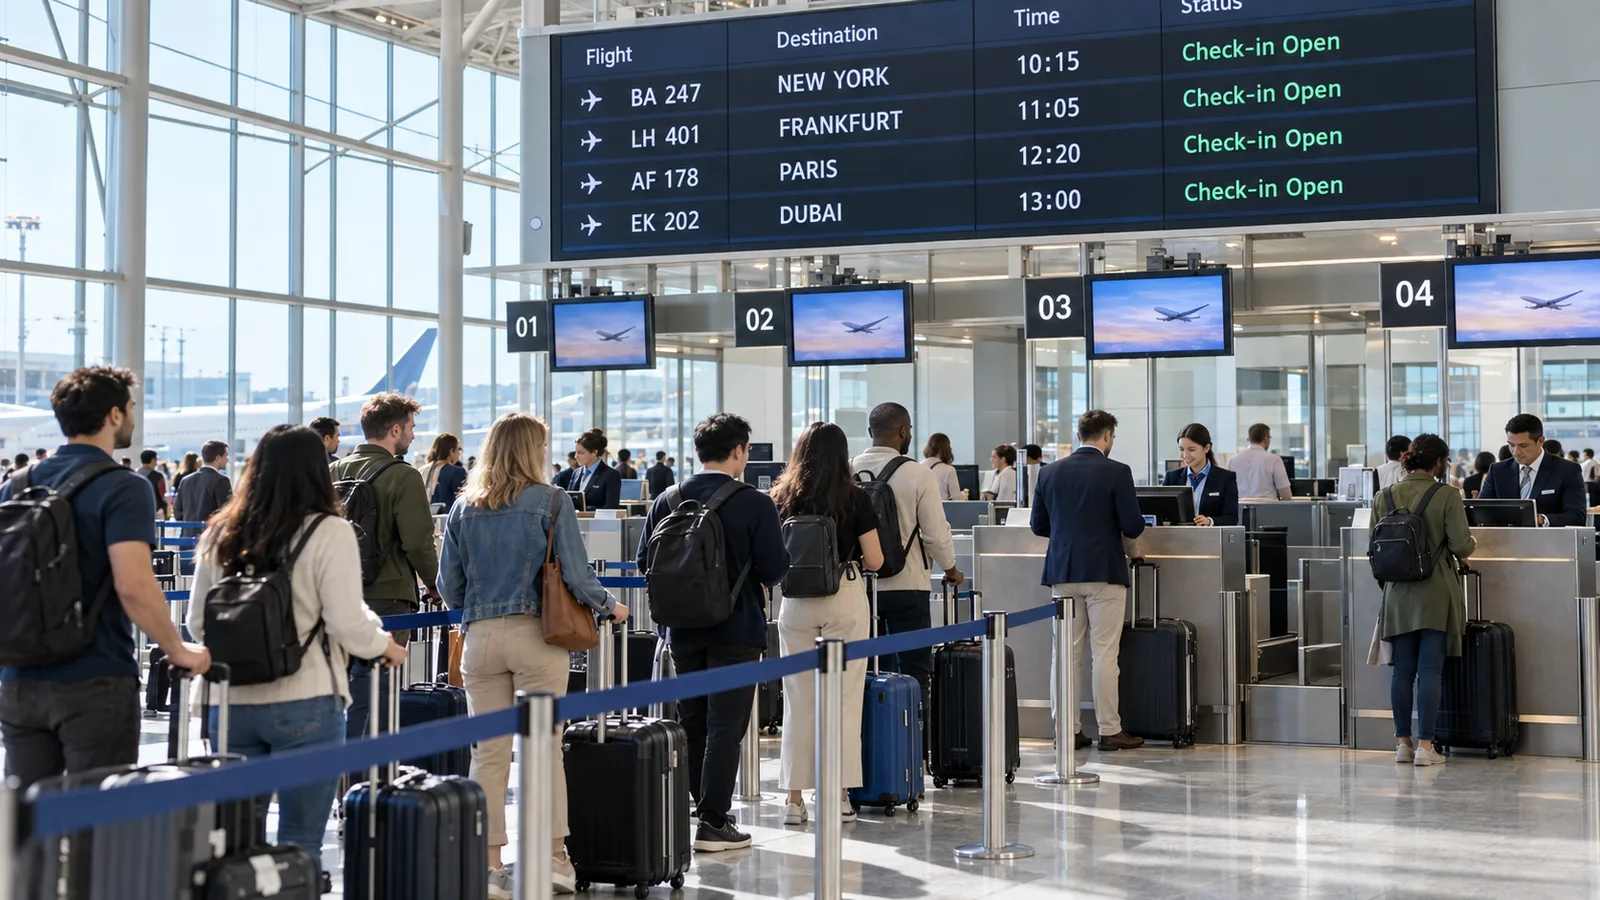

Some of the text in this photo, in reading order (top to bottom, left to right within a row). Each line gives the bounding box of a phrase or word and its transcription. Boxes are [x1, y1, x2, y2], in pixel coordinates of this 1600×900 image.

[1013, 7, 1060, 27] Time
[1181, 0, 1243, 14] Status
[777, 24, 878, 49] Destination
[1182, 34, 1340, 62] Check-in Open
[586, 45, 633, 68] Flight
[1017, 50, 1080, 75] 10:15
[778, 66, 890, 94] NEW YORK
[631, 82, 702, 107] BA 247
[1183, 81, 1342, 108] Check-in Open
[1018, 96, 1080, 121] 11:05
[779, 109, 903, 138] FRANKFURT
[631, 124, 699, 149] LH 401
[1183, 128, 1343, 154] Check-in Open
[1019, 143, 1081, 166] 12:20
[631, 167, 699, 191] AF 178
[780, 158, 838, 182] PARIS
[1019, 189, 1081, 212] 13:00
[1184, 177, 1343, 202] Check-in Open
[631, 210, 700, 233] EK 202
[780, 202, 842, 225] DUBAI
[1395, 279, 1434, 308] 04
[745, 307, 774, 332] 02
[1038, 293, 1072, 321] 03
[515, 315, 537, 338] 01
